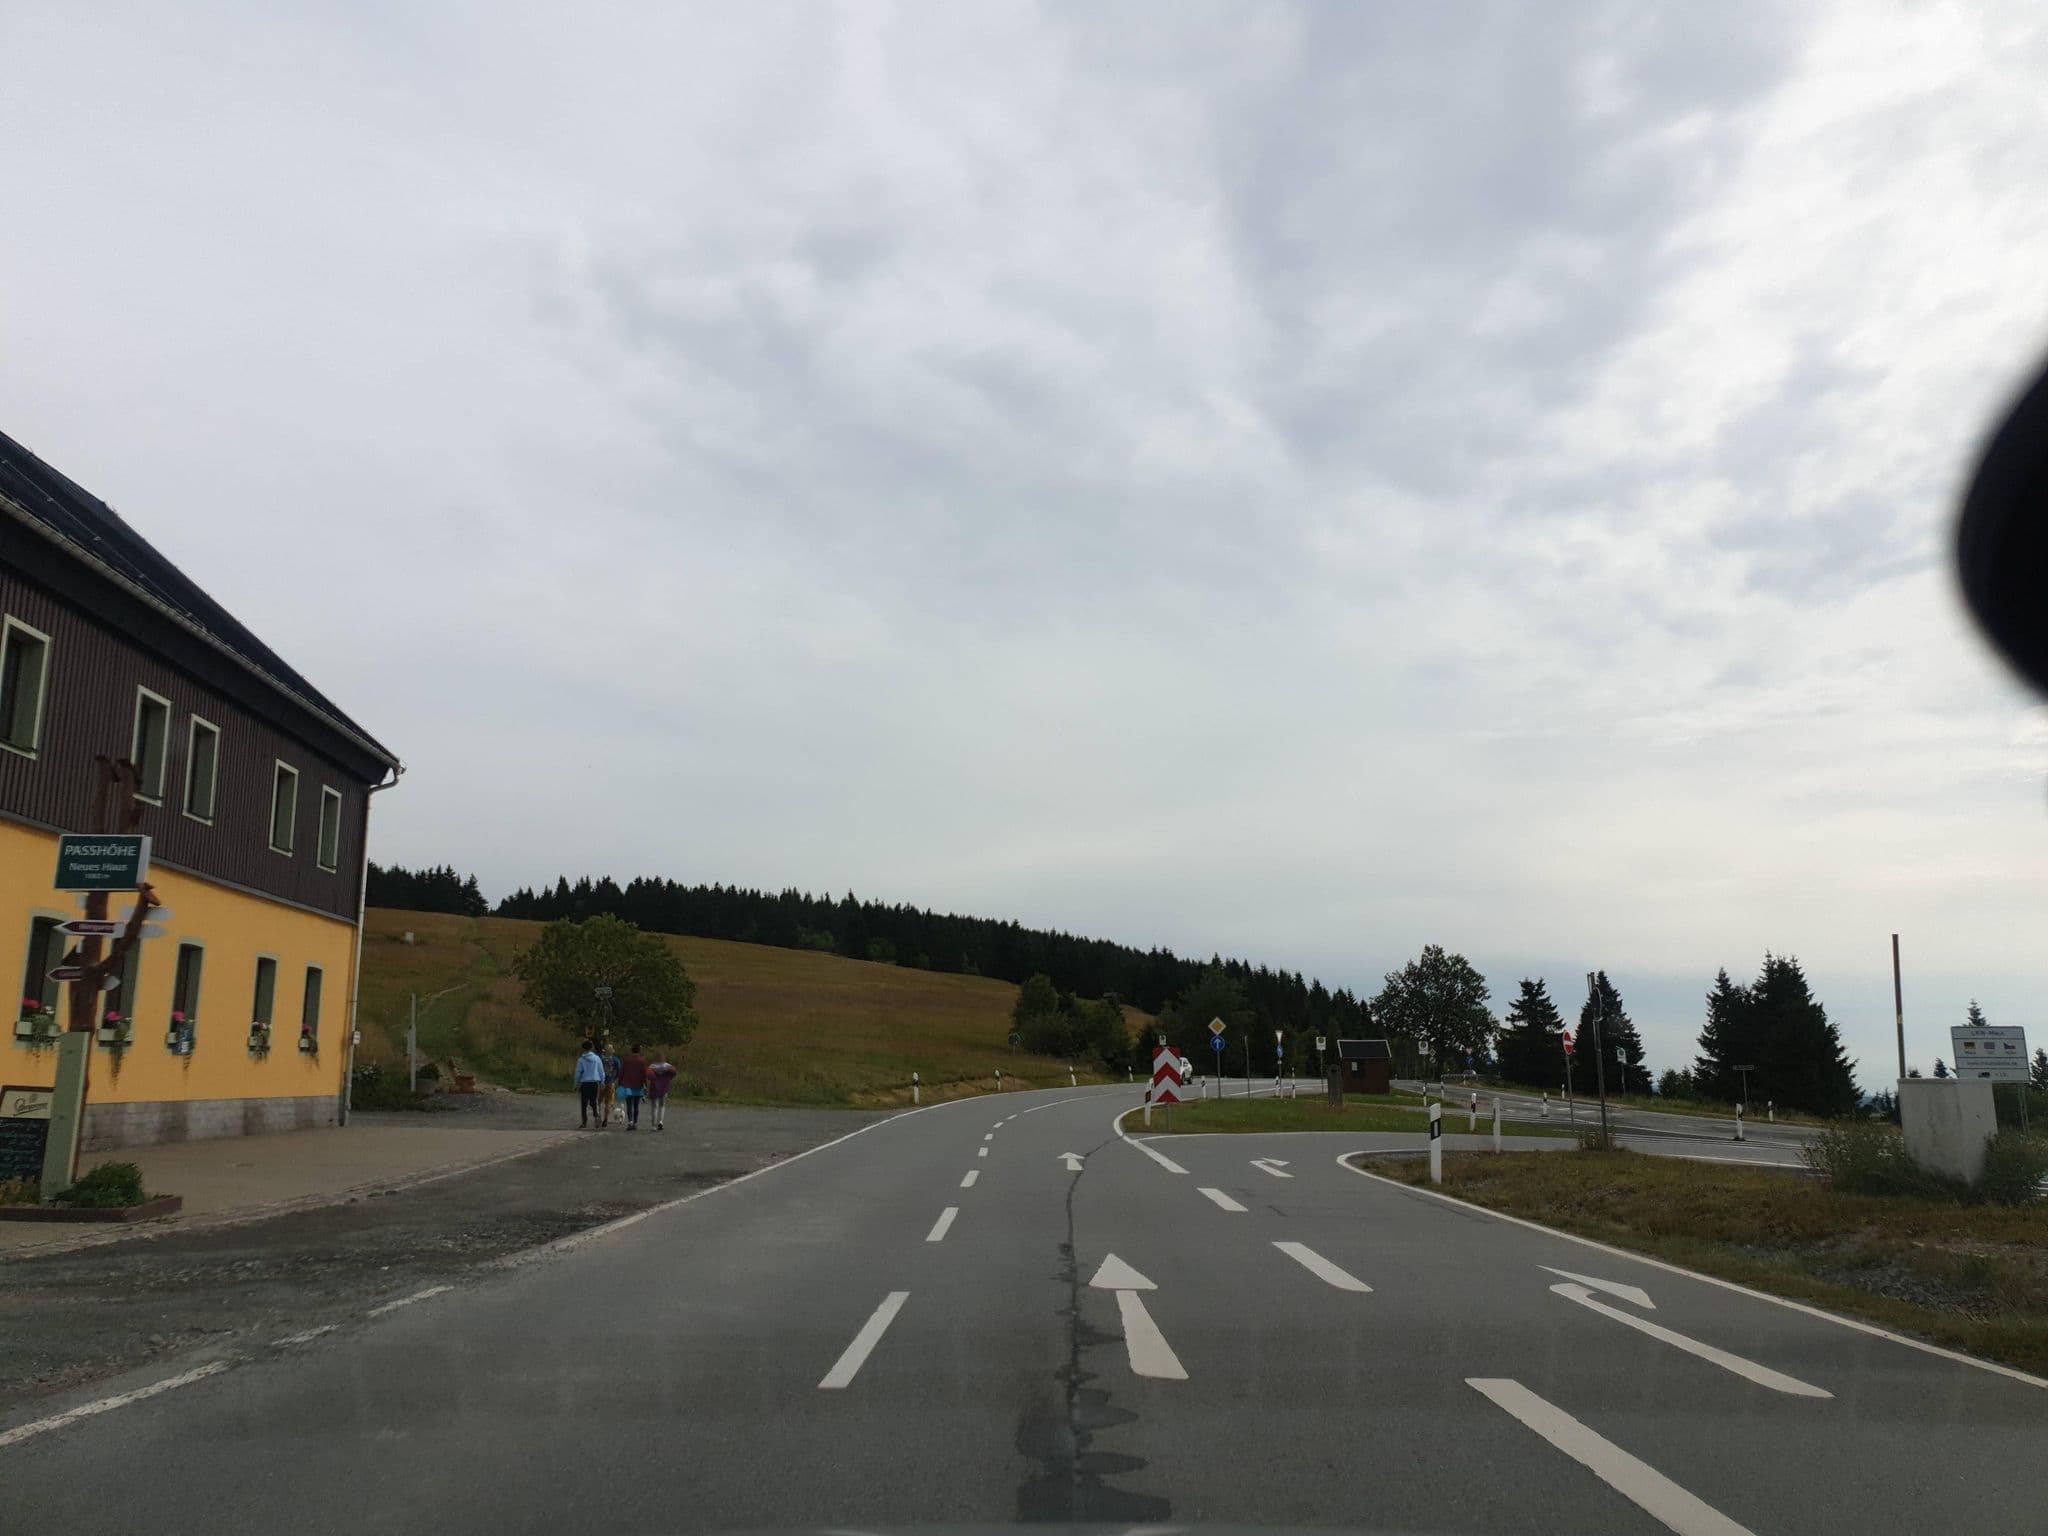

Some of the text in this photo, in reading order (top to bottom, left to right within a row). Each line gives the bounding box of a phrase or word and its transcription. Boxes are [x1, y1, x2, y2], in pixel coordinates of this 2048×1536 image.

[64, 843, 137, 856] PASSHÖHE
[68, 862, 128, 871] Neues Haus
